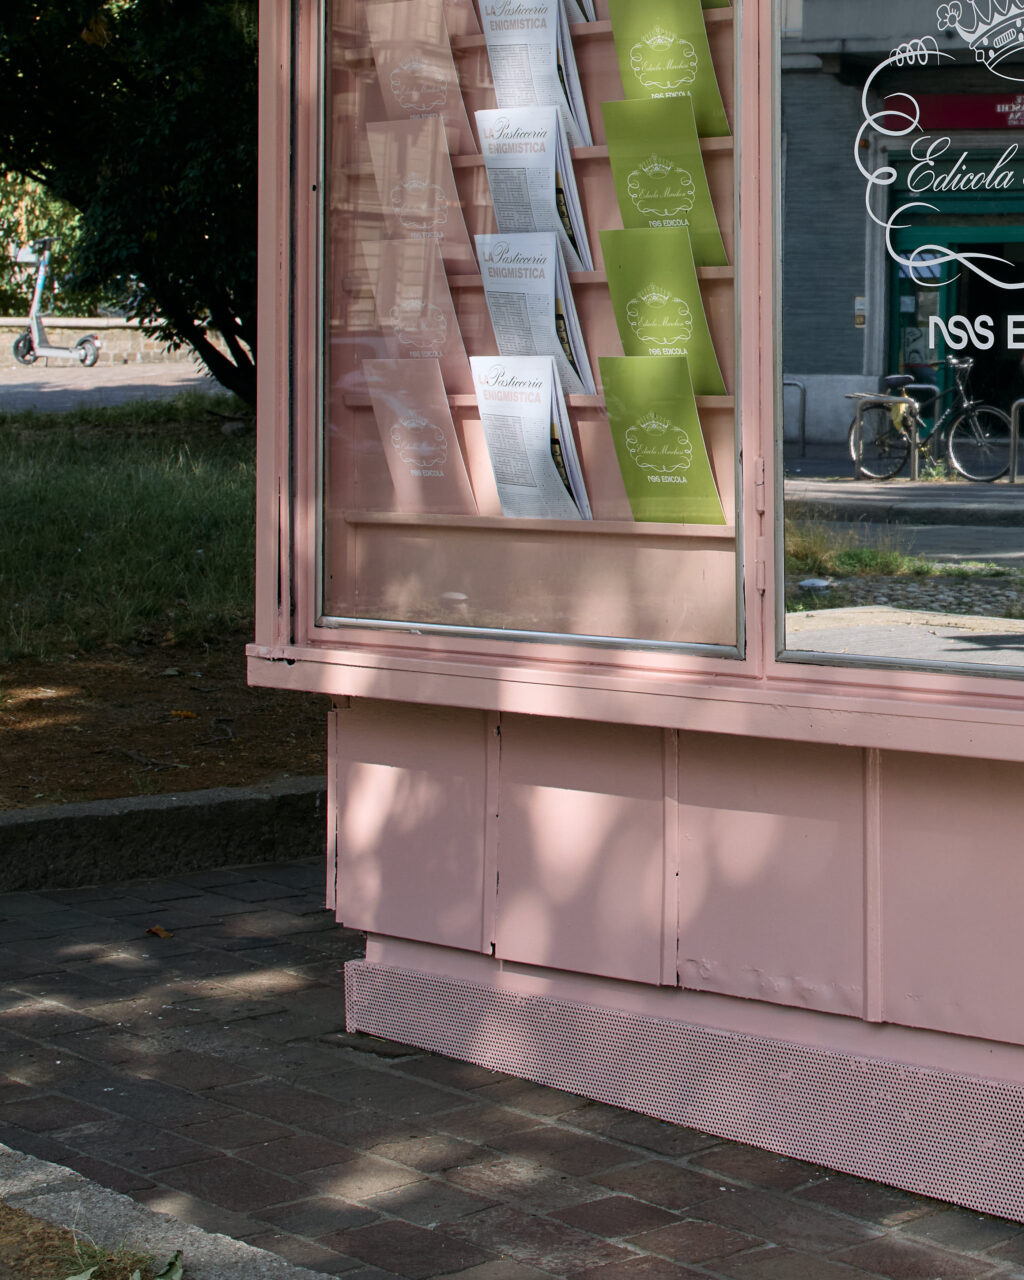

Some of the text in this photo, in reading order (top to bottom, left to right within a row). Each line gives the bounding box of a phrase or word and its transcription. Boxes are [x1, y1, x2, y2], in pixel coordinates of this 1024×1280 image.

[485, 5, 496, 16] LA
[490, 18, 547, 32] ENIGMISTICA
[483, 128, 494, 139] LA
[488, 142, 546, 154] ENIGMISTICA
[906, 136, 1019, 193] Edicola
[483, 251, 494, 263] LA
[488, 267, 545, 279] ENIGMISTICA
[478, 374, 489, 385] LA
[483, 390, 541, 404] ENIGMISTICA
